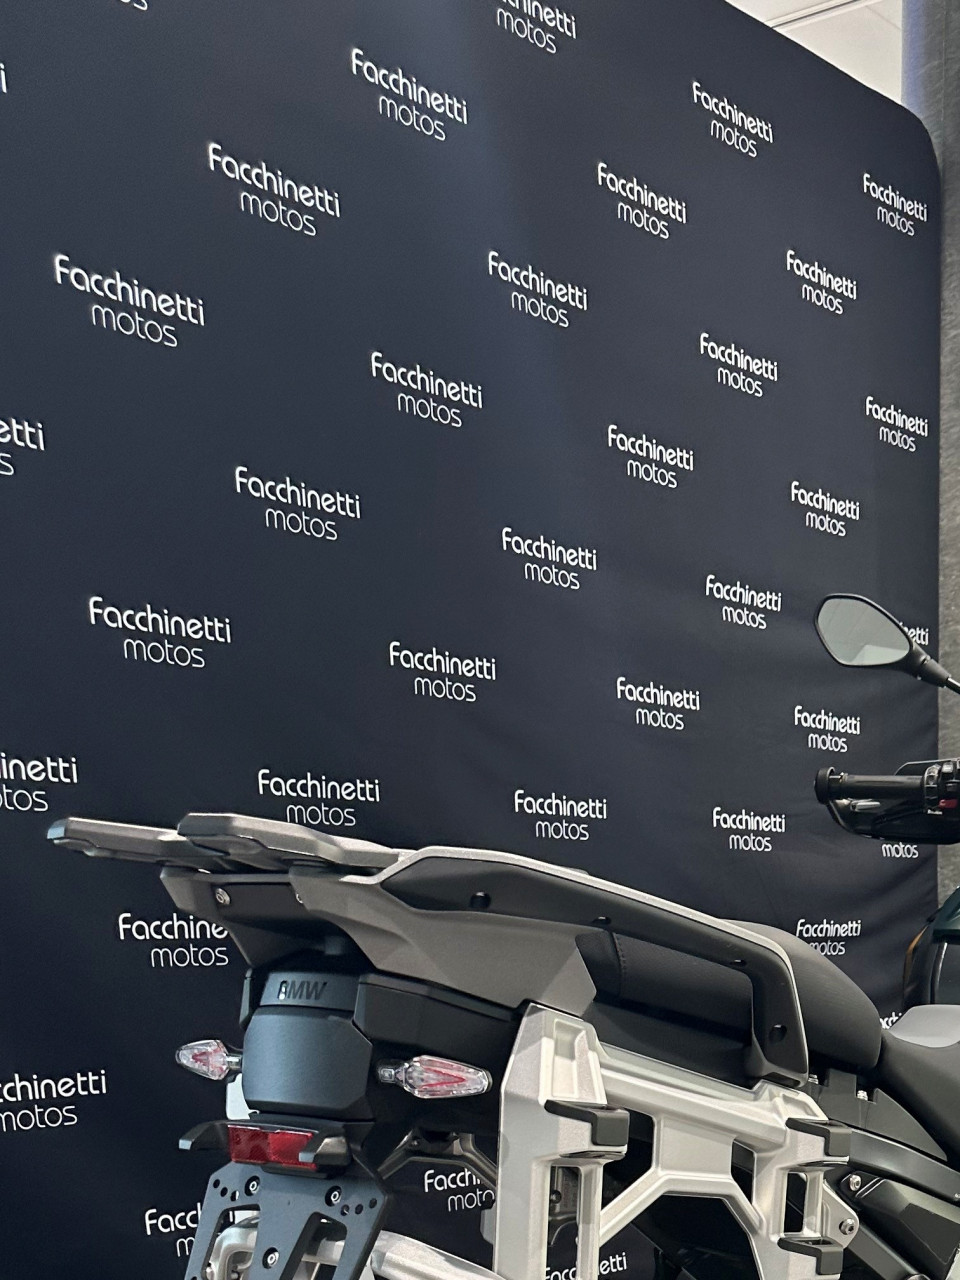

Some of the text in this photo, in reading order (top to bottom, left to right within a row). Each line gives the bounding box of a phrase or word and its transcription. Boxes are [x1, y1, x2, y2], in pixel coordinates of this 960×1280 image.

[496, 8, 557, 54] motos
[502, 0, 577, 39] inetti
[352, 48, 468, 124] Facchinetti
[379, 95, 446, 141] motos
[693, 82, 773, 143] Facchinetti
[711, 120, 757, 158] motos
[208, 143, 340, 217] Facchinetti
[597, 163, 686, 223] Facchinetti
[240, 192, 317, 236] motos
[864, 173, 927, 222] Facchinetti
[618, 202, 669, 239] motos
[877, 206, 915, 236] motos
[54, 254, 205, 326] Facchinetti
[488, 251, 587, 311] Facchinetti
[786, 250, 857, 300] Facchinetti
[511, 292, 569, 328] motos
[801, 284, 843, 315] motos
[92, 305, 178, 347] motos
[700, 333, 777, 381] Facchinetti
[371, 352, 483, 408] Facchinetti
[717, 367, 763, 398] motos
[398, 393, 463, 427] motos
[866, 396, 928, 438] Facchinetti
[608, 425, 694, 471] Facchinetti
[879, 427, 916, 452] motos
[627, 458, 677, 488] motos
[235, 466, 361, 518] Facchinetti
[791, 481, 860, 521] Facchinetti
[265, 508, 338, 541] motos
[805, 510, 846, 537] motos
[502, 527, 597, 570] Facchinetti
[523, 562, 580, 590] motos
[706, 574, 782, 612] Facchinetti
[89, 597, 231, 642] Facchinetti
[722, 604, 767, 630] motos
[123, 638, 205, 668] motos
[390, 641, 496, 680] Facchinetti
[414, 677, 477, 701] motos
[616, 676, 700, 710] Facchinetti
[636, 706, 684, 730] motos
[794, 705, 861, 735] Facchinetti
[808, 732, 848, 753] motos
[0, 752, 78, 784] inetti
[258, 768, 380, 802] Facchinetti
[0, 784, 48, 812] tos
[286, 803, 356, 826] motos
[514, 789, 607, 820] Facchinetti
[535, 819, 589, 841] motos
[712, 806, 786, 833] Facchinetti
[729, 832, 772, 852] motos
[881, 842, 919, 859] motos
[118, 913, 228, 940] Facchine
[796, 918, 862, 938] Facchinetti
[151, 945, 229, 968] motos
[277, 979, 328, 1000] BMW
[0, 1069, 107, 1103] chinetti
[447, 1188, 495, 1212] moto
